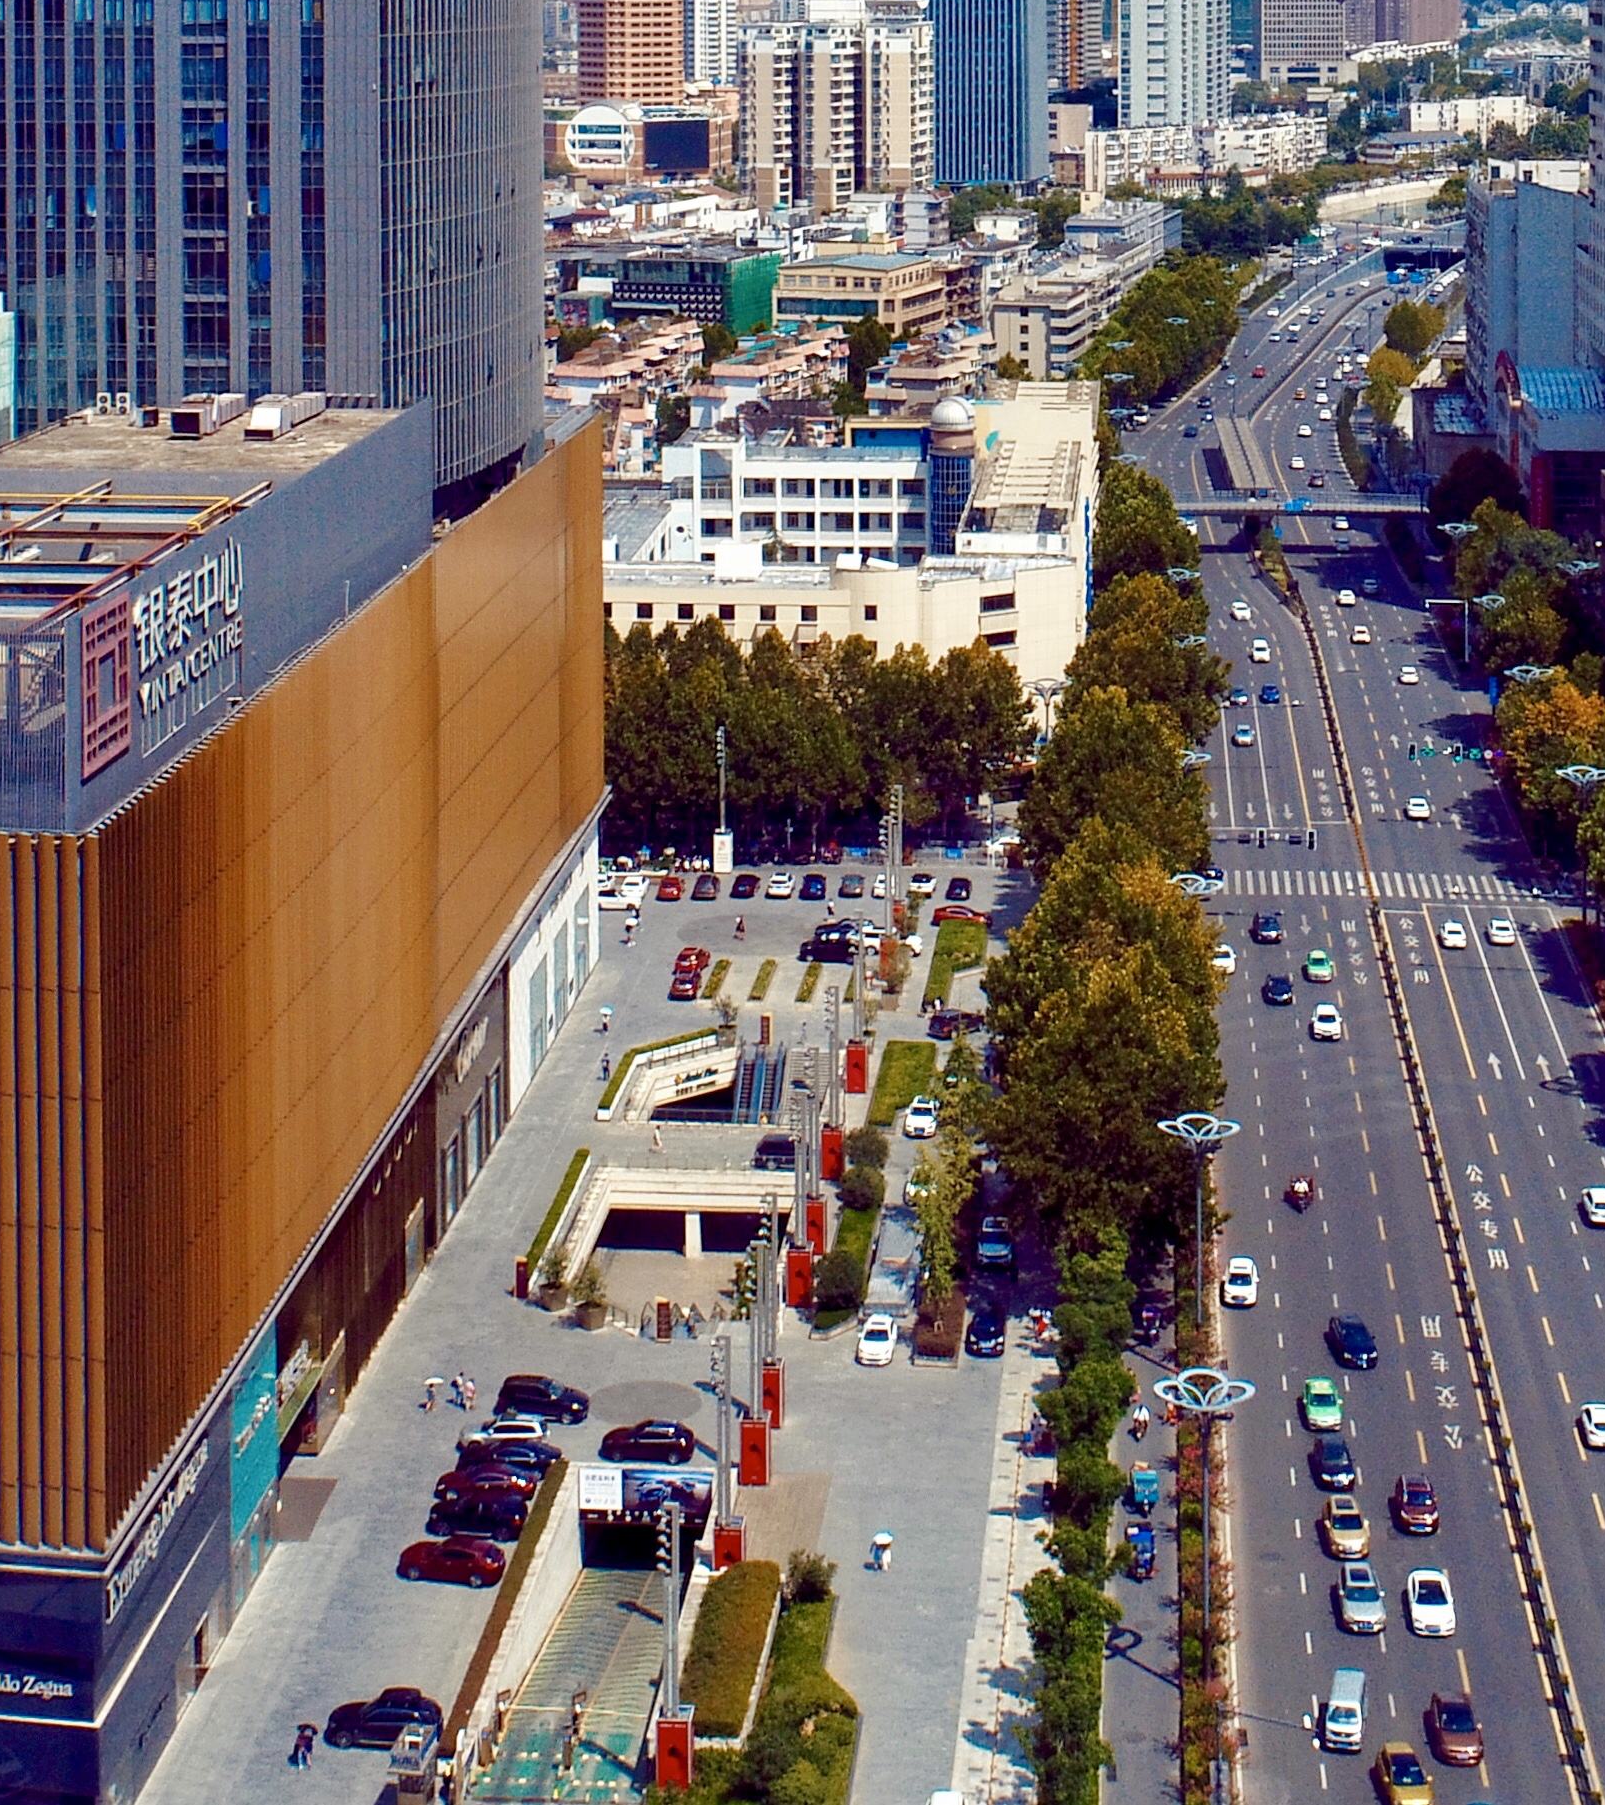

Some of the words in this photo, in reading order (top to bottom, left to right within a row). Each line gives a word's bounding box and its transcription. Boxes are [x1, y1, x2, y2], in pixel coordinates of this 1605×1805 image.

[133, 536, 243, 673] 银泰中心
[191, 616, 243, 679] CENTRE
[1465, 1164, 1509, 1270] 公交专用
[1420, 1315, 1463, 1450] 公交专用
[23, 1675, 73, 1700] Zegna
